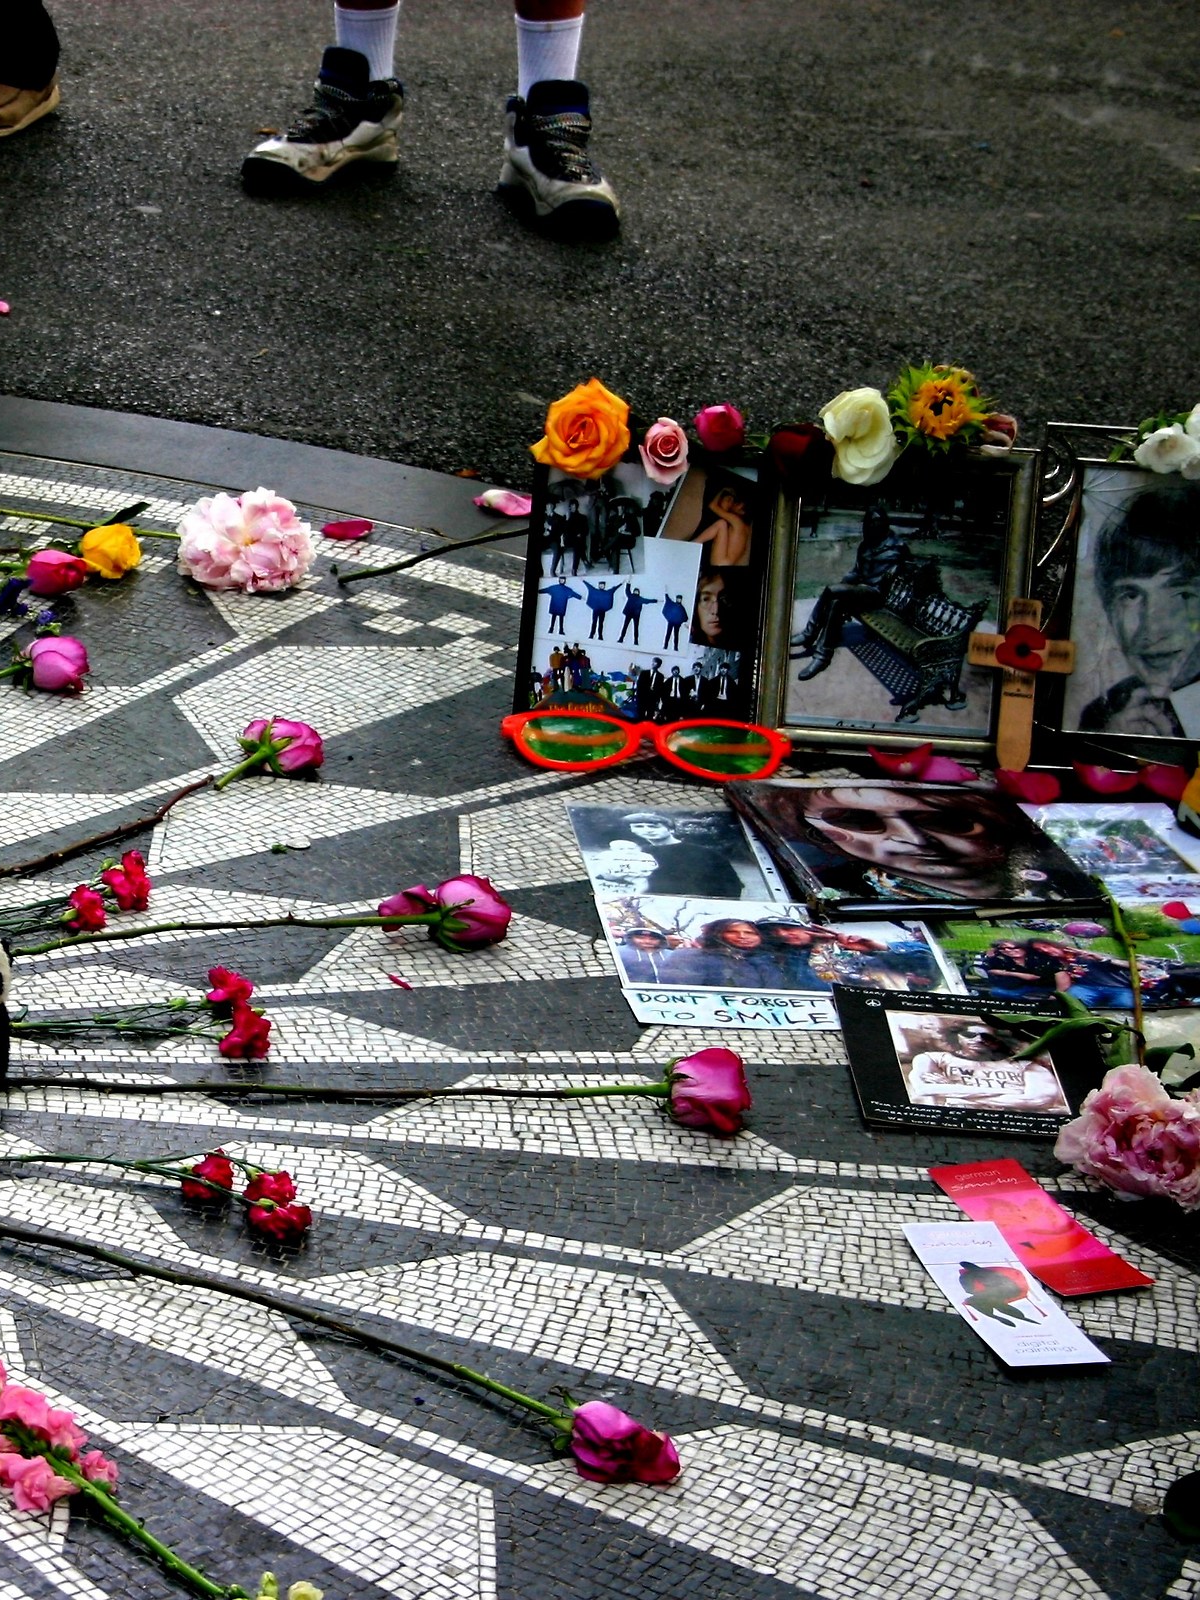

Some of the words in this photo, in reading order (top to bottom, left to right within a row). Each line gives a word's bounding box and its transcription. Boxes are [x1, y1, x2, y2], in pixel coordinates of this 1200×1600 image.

[720, 995, 827, 1008] FORGET
[650, 1009, 696, 1020] TO
[961, 1076, 1007, 1088] CITY
